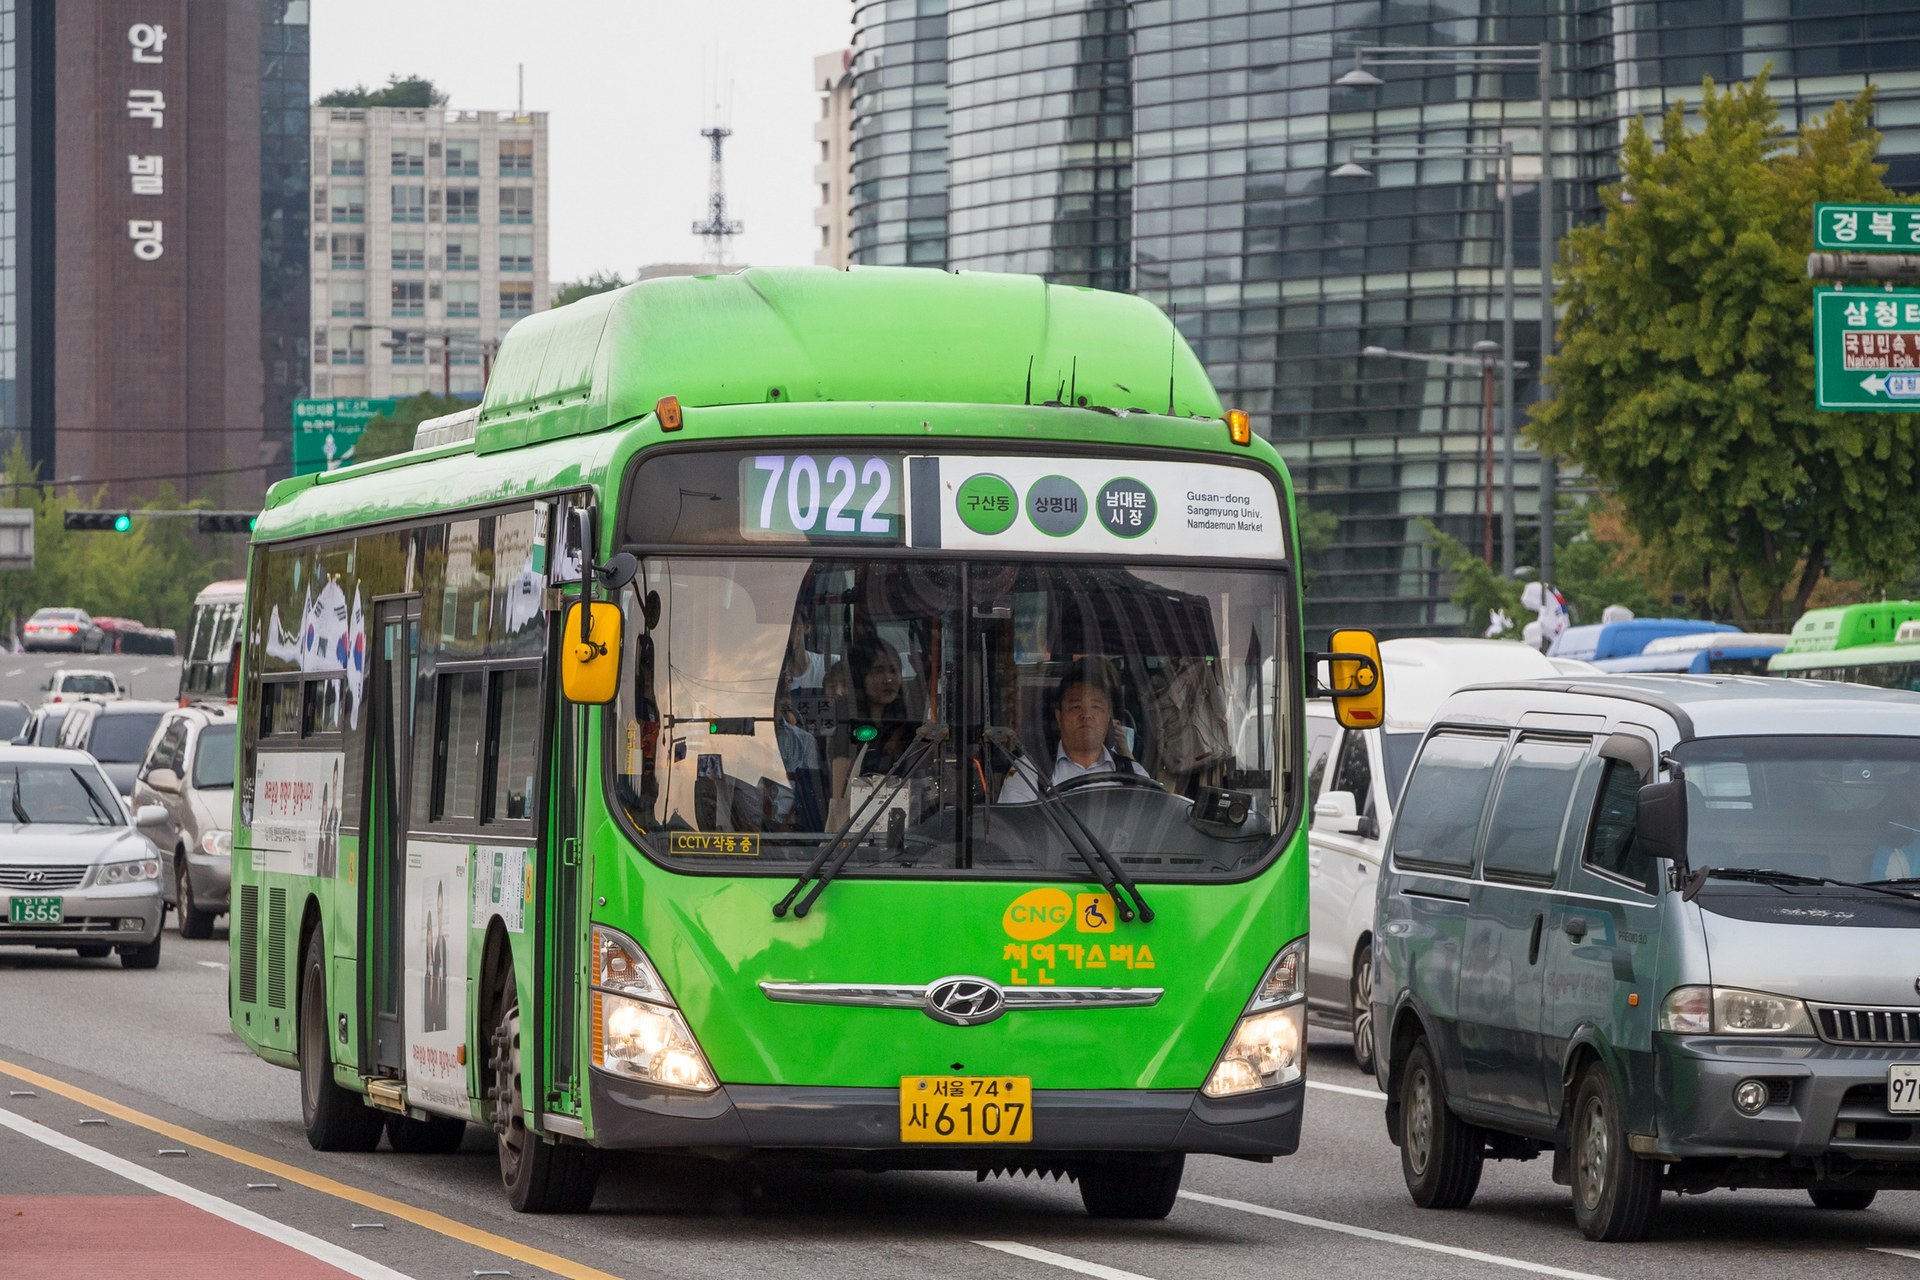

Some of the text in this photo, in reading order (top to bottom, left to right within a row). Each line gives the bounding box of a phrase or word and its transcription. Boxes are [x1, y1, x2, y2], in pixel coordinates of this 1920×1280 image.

[127, 22, 167, 261] 안국빌딩
[1847, 354, 1914, 369] National Folk
[754, 455, 891, 534] 7022
[1106, 490, 1147, 509] 남대문
[1186, 491, 1251, 506] Gusan-dong
[966, 495, 1010, 513] 구산동
[1034, 497, 1078, 514] 상명대
[1187, 505, 1263, 519] Sangmyung Univ.
[1187, 519, 1264, 533] Namdaemun Market
[678, 835, 752, 853] CCTV 작동 중
[16, 905, 60, 922] 1555
[1010, 904, 1066, 924] CNG
[1003, 943, 1155, 985] 천연가스버스
[933, 1080, 999, 1097] 서울 74
[1892, 1078, 1920, 1103] 97
